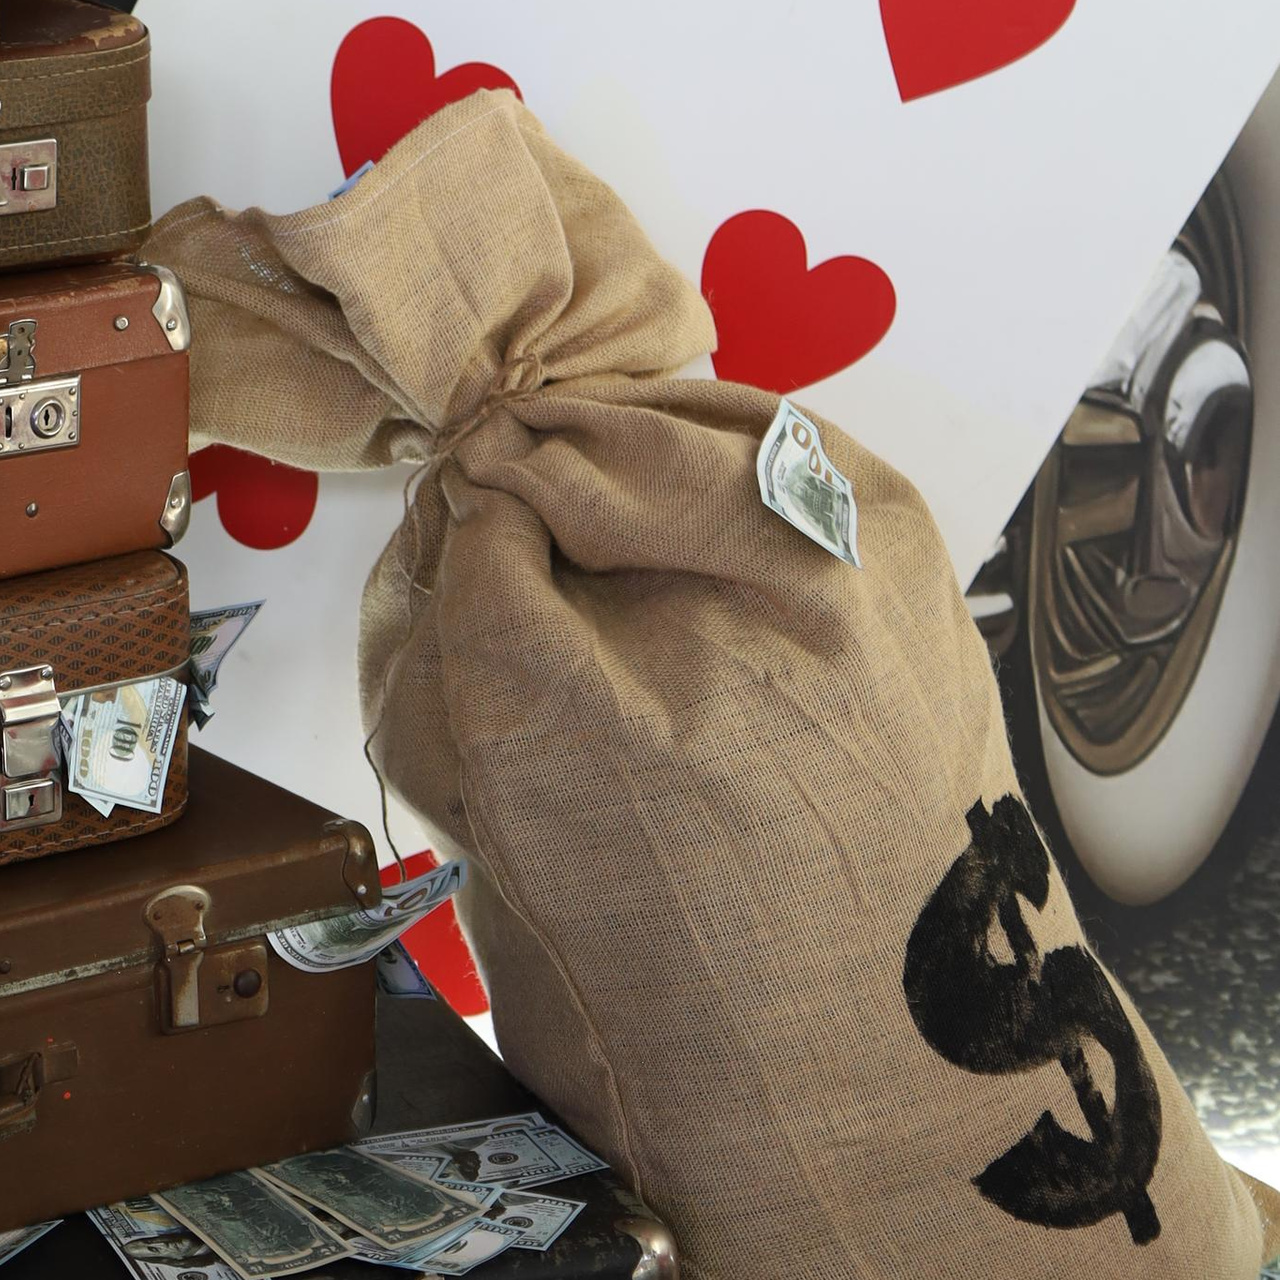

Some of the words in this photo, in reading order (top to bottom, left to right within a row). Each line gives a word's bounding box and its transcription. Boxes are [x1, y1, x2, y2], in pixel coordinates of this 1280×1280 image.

[77, 729, 93, 778] 100
[108, 718, 142, 763] 100
[147, 759, 162, 796] 100
